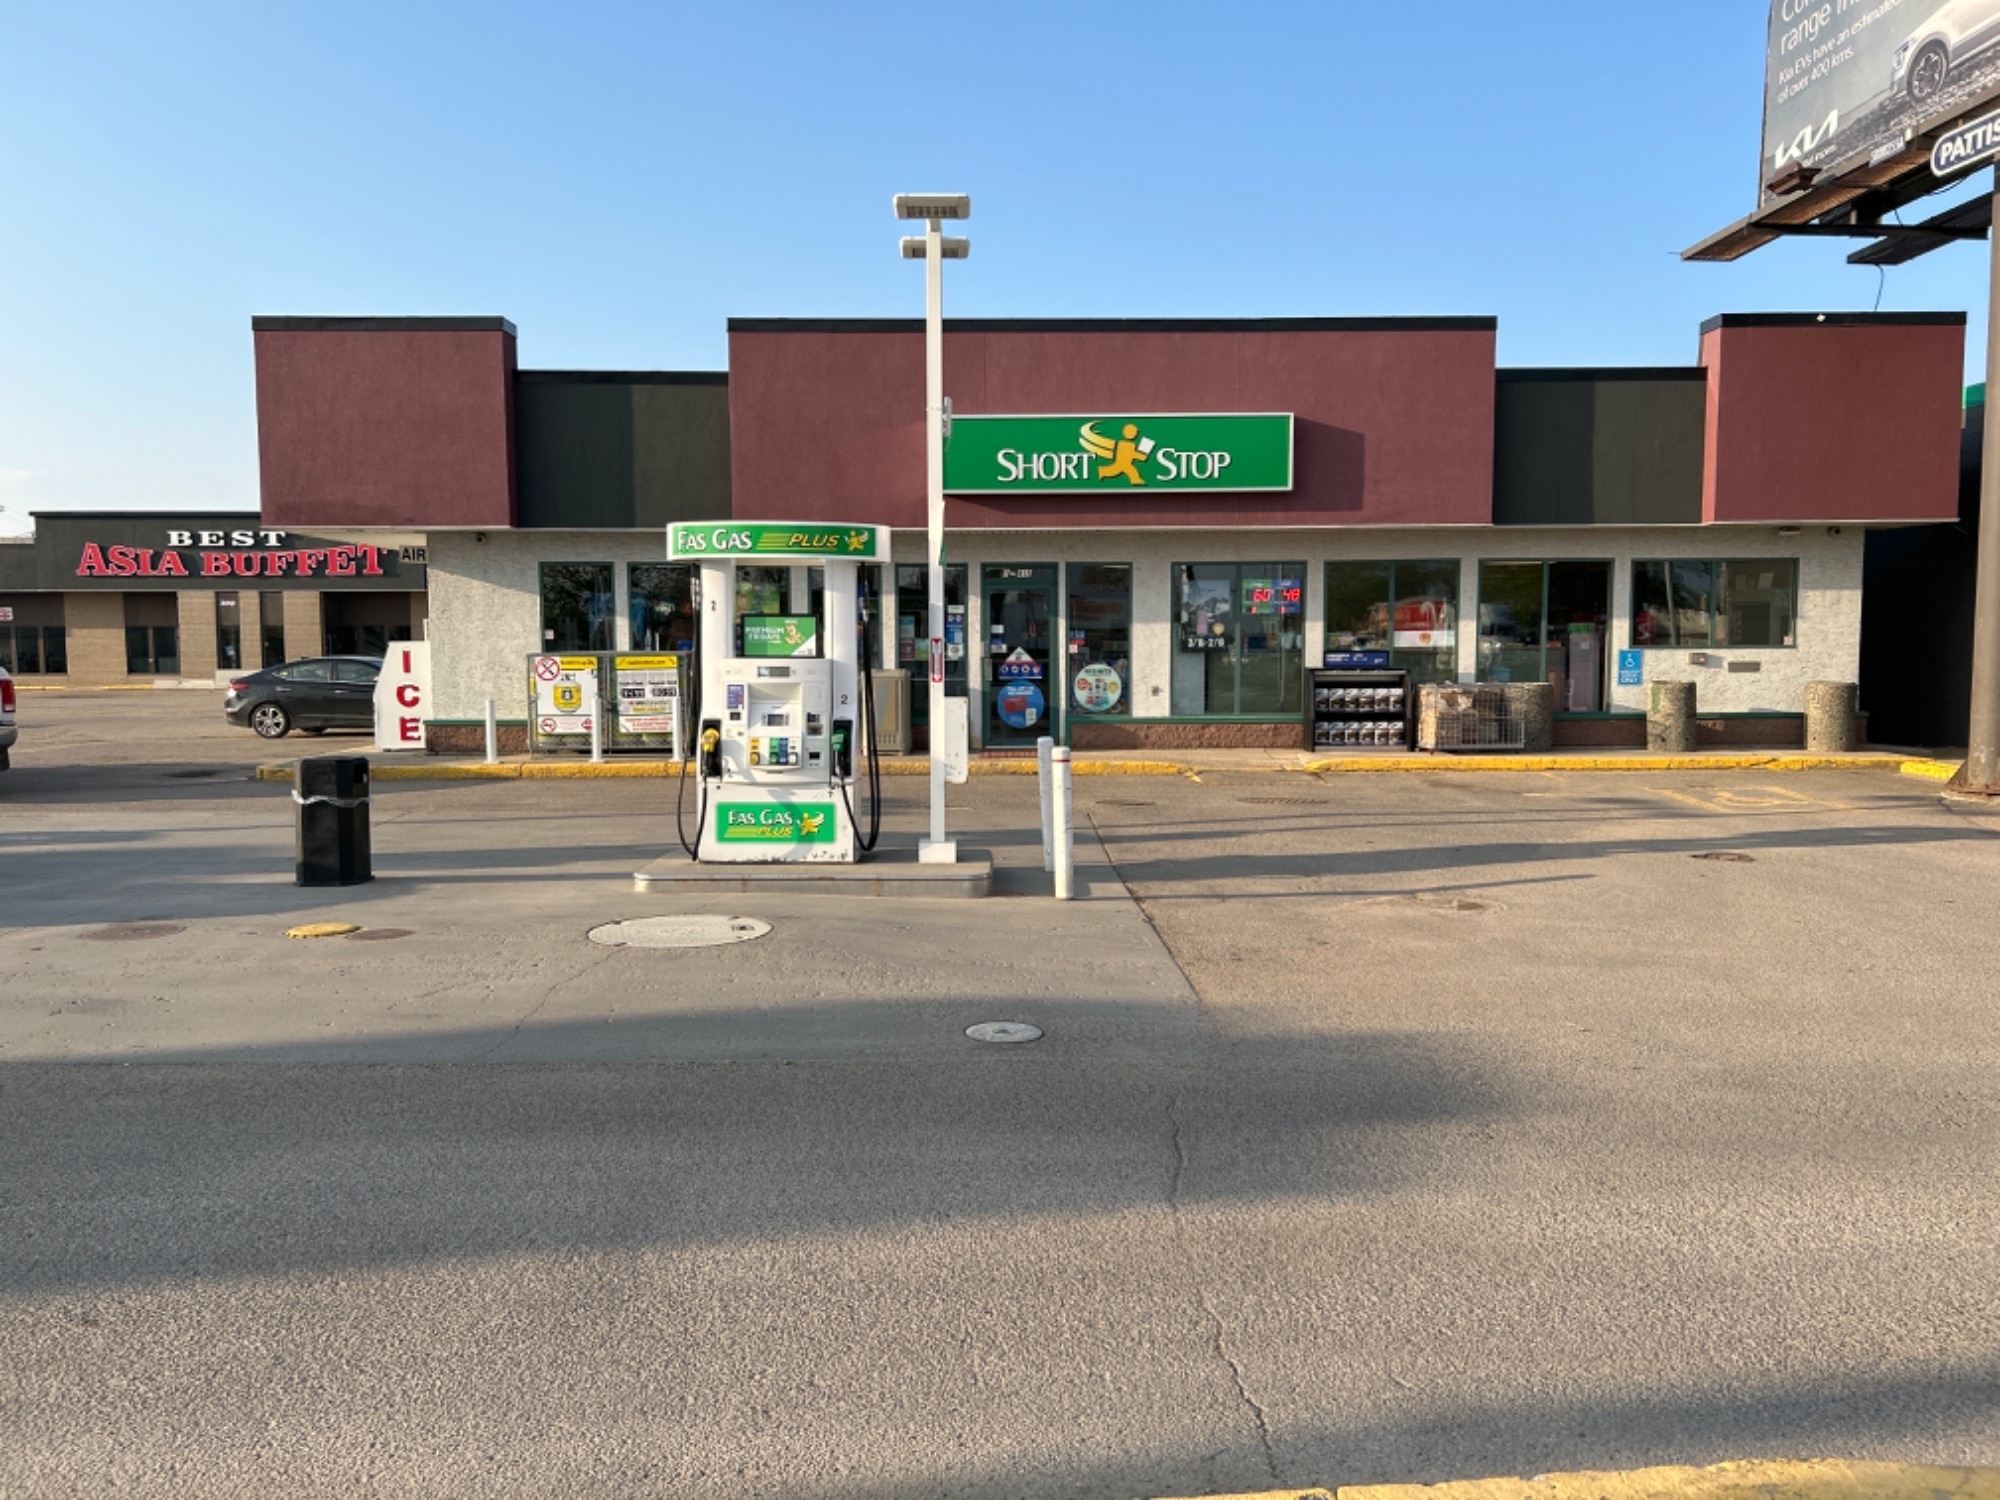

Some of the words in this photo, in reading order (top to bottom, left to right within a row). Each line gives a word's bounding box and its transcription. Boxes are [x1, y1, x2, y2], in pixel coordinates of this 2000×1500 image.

[1781, 3, 1832, 55] range
[1813, 38, 1836, 62] have
[1837, 29, 1850, 45] an
[1789, 75, 1809, 97] over
[997, 449, 1095, 482] SHORT
[1156, 448, 1231, 481] STOP
[167, 531, 286, 546] BEST
[677, 531, 706, 552] FAS
[712, 529, 752, 550] GAS
[788, 533, 839, 547] PLUS
[77, 542, 189, 576] ASIA
[200, 544, 385, 576] BUFFET
[401, 547, 427, 562] AIR
[396, 650, 421, 742] ICE
[841, 694, 848, 705] 2
[728, 810, 755, 824] FAS
[760, 809, 793, 824] GAS
